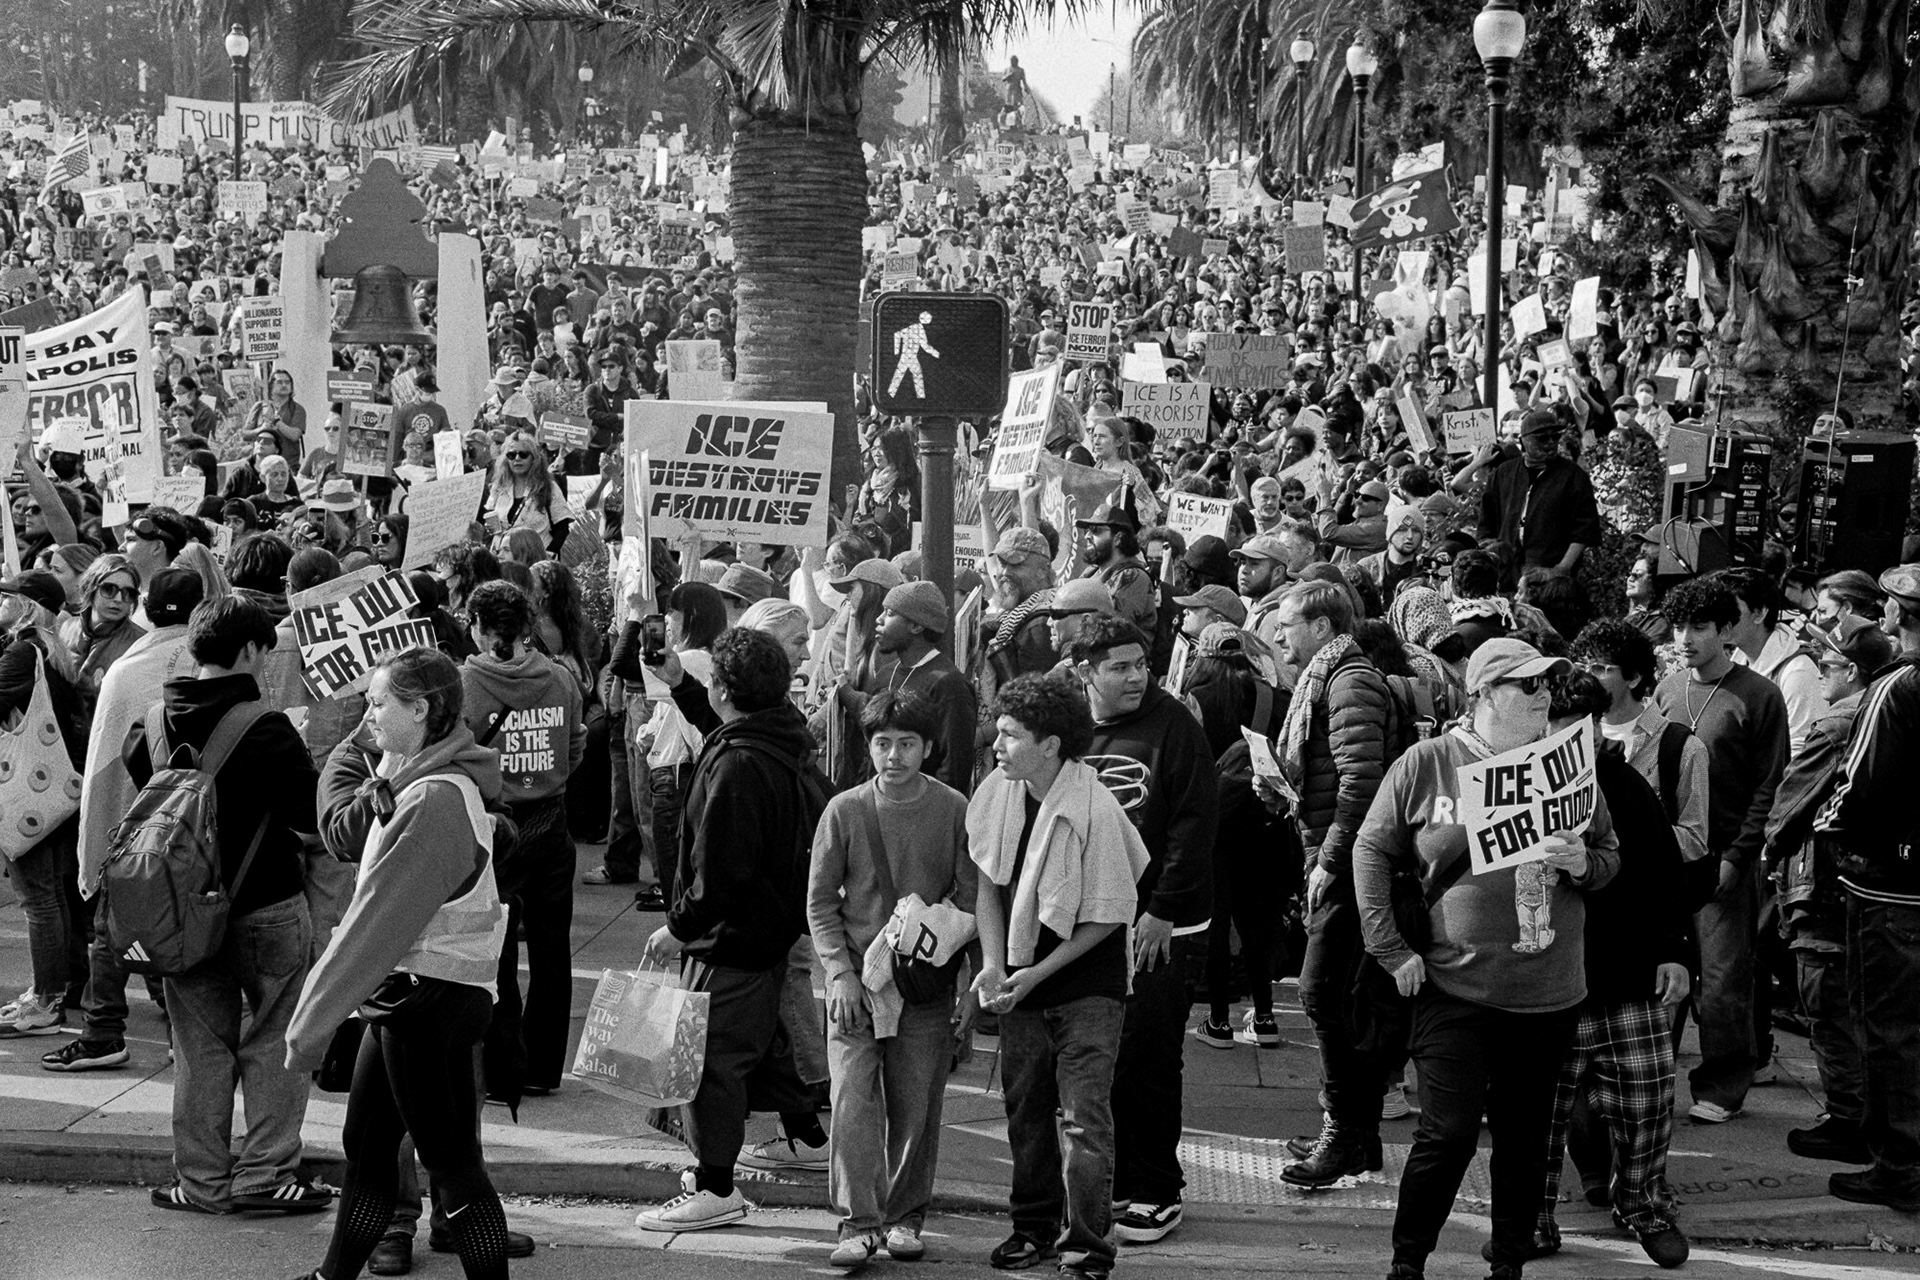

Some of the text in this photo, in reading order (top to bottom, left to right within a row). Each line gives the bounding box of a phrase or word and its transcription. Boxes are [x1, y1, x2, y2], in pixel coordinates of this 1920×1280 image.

[176, 105, 260, 139] TRUMP
[269, 115, 320, 144] MUST
[62, 231, 99, 247] FUCK
[63, 246, 95, 260] ICE
[244, 307, 282, 319] BILLIONAIRES
[245, 318, 282, 329] SUPPORT ICE
[1071, 304, 1110, 328] STOP
[45, 326, 119, 359] BAY
[249, 331, 281, 342] PEACE AND
[251, 342, 278, 352] FREEDOM
[1069, 333, 1107, 346] ICE TERROR
[1068, 344, 1106, 353] NOW!
[1015, 376, 1045, 417] ICE
[1134, 384, 1199, 401] ICE IS A
[361, 415, 379, 424] STOP
[1124, 404, 1205, 421] TERRORIST
[1446, 412, 1479, 431] Kristi
[685, 413, 786, 461] ICE
[1154, 428, 1204, 440] NIZATION
[649, 459, 822, 496] DESTROYS
[651, 492, 812, 526] FAMILIES
[1178, 498, 1229, 516] WE WANT
[1171, 512, 1209, 527] LIBERTY
[292, 570, 418, 647] ICE OUT
[300, 643, 366, 701] FOR
[505, 729, 551, 753] IS THE
[500, 749, 555, 774] FUTURE
[1484, 727, 1586, 807] ICE OUT
[1476, 782, 1594, 865] FOR GOOD!
[909, 922, 939, 960] P
[592, 1005, 619, 1027] The
[586, 1025, 616, 1046] way
[578, 1057, 620, 1079] salad.
